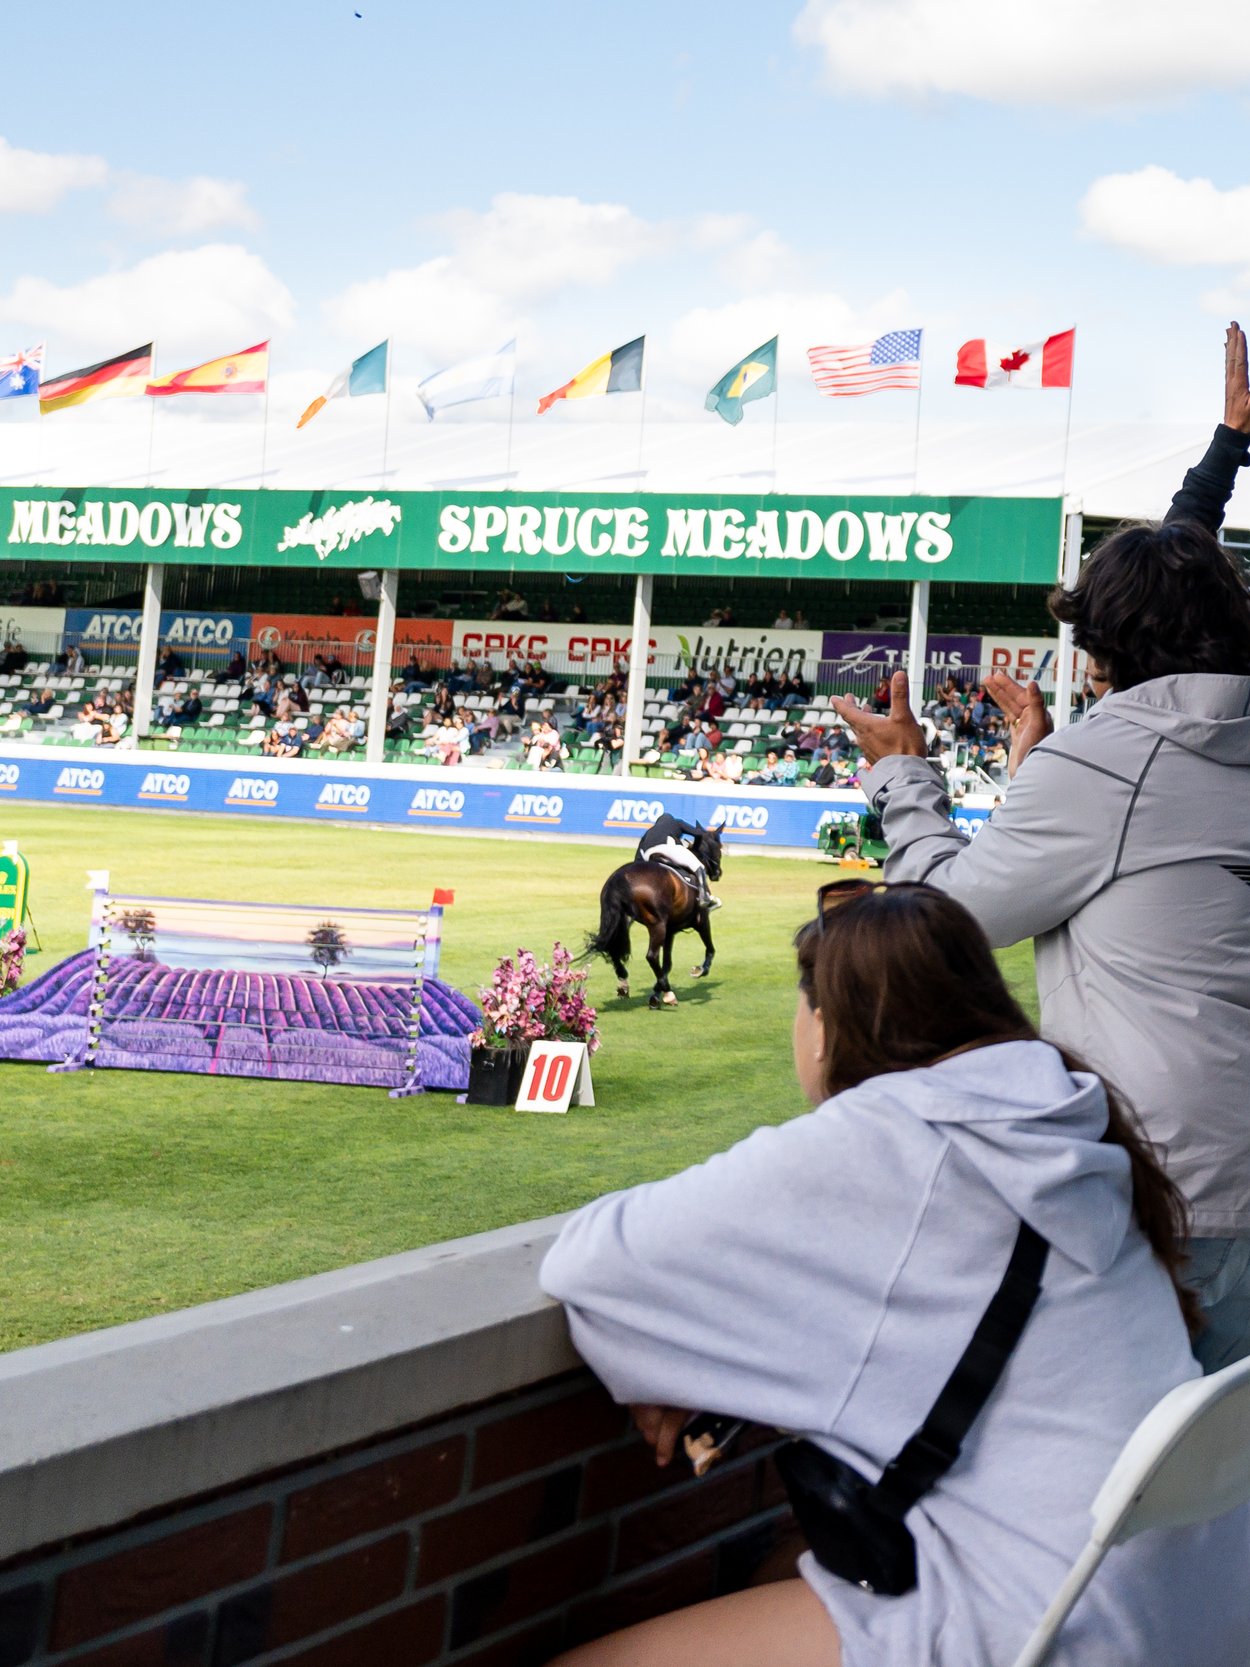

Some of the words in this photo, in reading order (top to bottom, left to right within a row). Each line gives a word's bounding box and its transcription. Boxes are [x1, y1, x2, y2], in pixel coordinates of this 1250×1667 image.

[7, 500, 243, 549] MEADOWS
[437, 504, 650, 557] SPRUCE
[660, 508, 954, 563] MEADOWS
[165, 617, 233, 645] ATCO
[462, 633, 548, 661] CPKC
[673, 635, 806, 675] Nutrien
[886, 650, 962, 670] TEUS
[0, 764, 20, 784] CO
[57, 767, 104, 789] ATCO
[141, 772, 190, 795] ATCO
[228, 778, 279, 800] ATCO
[318, 783, 371, 806] ATCO
[411, 788, 465, 811] ATCO
[508, 794, 563, 817] ATCO
[606, 799, 665, 823] ATCO
[709, 804, 769, 829] ATCO
[527, 1054, 573, 1102] 10
